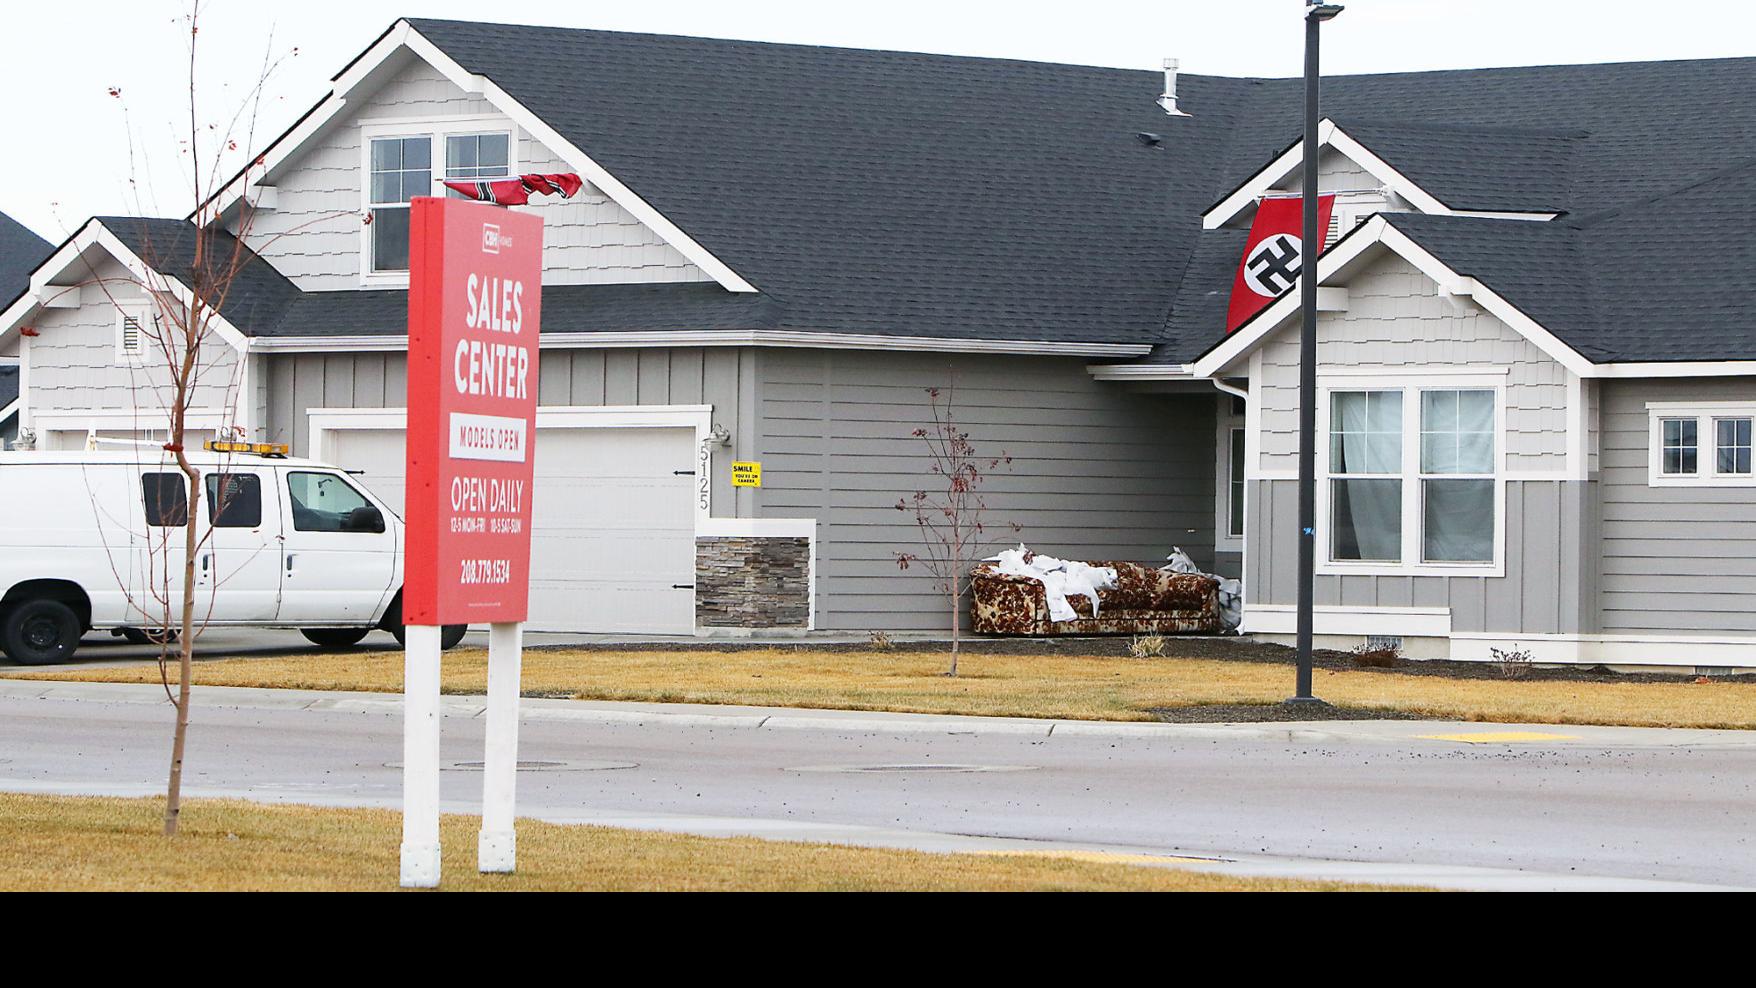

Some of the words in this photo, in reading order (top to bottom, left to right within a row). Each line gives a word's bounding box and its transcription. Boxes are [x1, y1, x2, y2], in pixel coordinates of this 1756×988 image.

[466, 273, 523, 334] SALES
[454, 339, 529, 400] CENTER
[460, 426, 495, 449] MODELS
[498, 429, 519, 451] OPEN
[451, 476, 487, 513] OPEN
[490, 478, 524, 513] DAILY
[700, 446, 708, 510] 5125
[450, 517, 462, 533] 12-5
[462, 517, 485, 533] MON-FRI
[490, 518, 501, 534] 10-5
[501, 518, 522, 534] SAT-SUN
[460, 559, 510, 585] 208.779.1534
